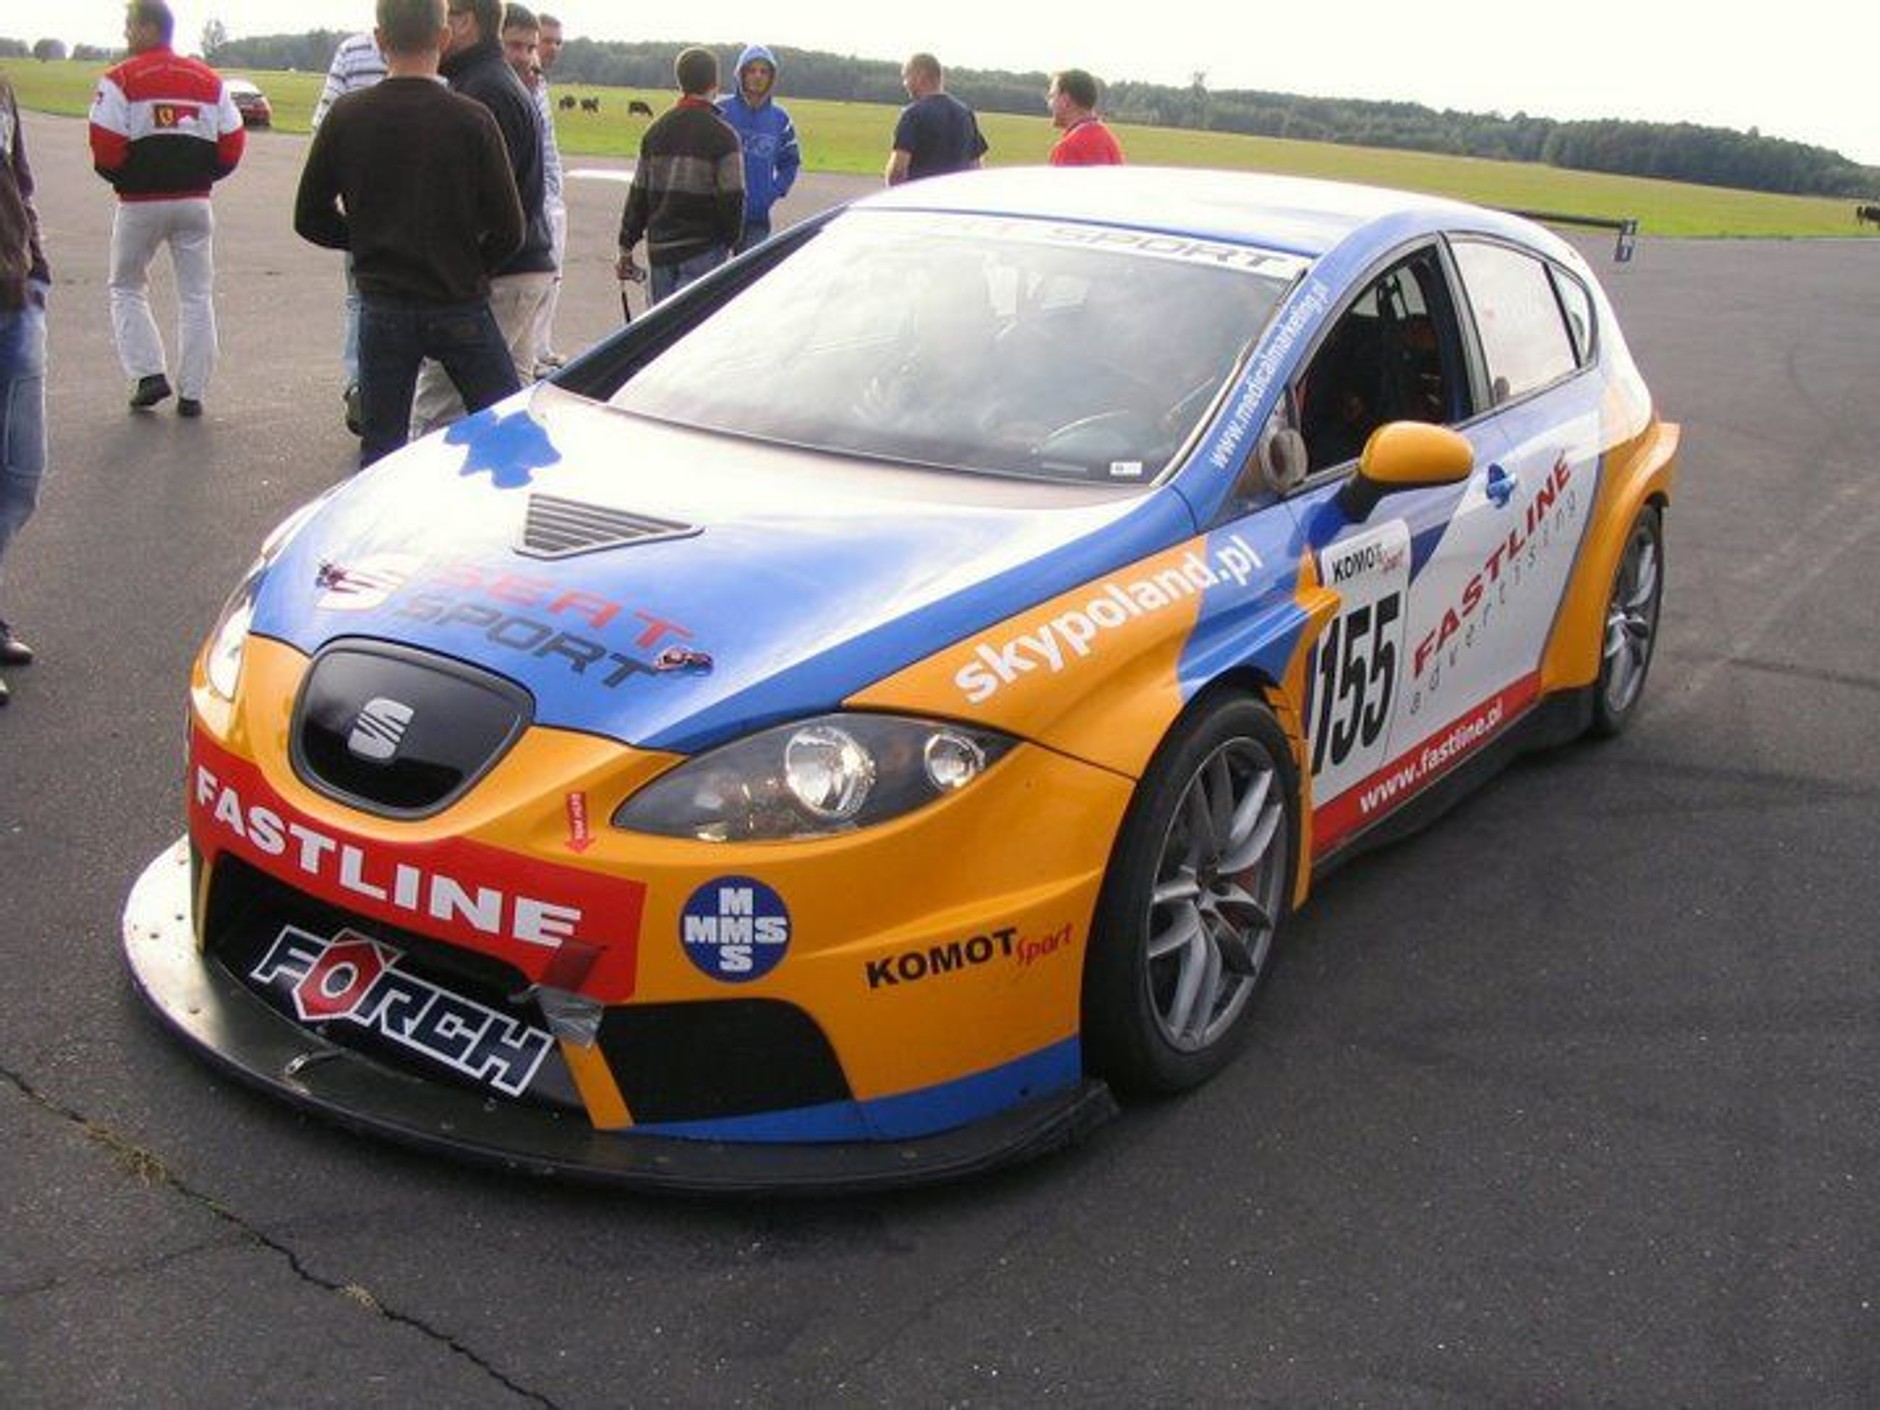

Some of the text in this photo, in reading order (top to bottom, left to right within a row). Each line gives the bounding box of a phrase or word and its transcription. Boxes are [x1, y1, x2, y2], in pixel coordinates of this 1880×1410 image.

[1046, 227, 1286, 269] SPORT
[429, 557, 694, 649] SEAT
[955, 535, 1263, 704] skypoland.pl
[1332, 543, 1382, 583] KOMOT
[1409, 490, 1576, 716] advertising
[1413, 448, 1571, 680] FASTLINE
[398, 595, 658, 688] SPORT
[1311, 590, 1400, 777] 155
[1360, 697, 1503, 813] www.fastline.pl
[196, 765, 582, 949] FASTLINE
[865, 927, 1017, 988] KOMOT
